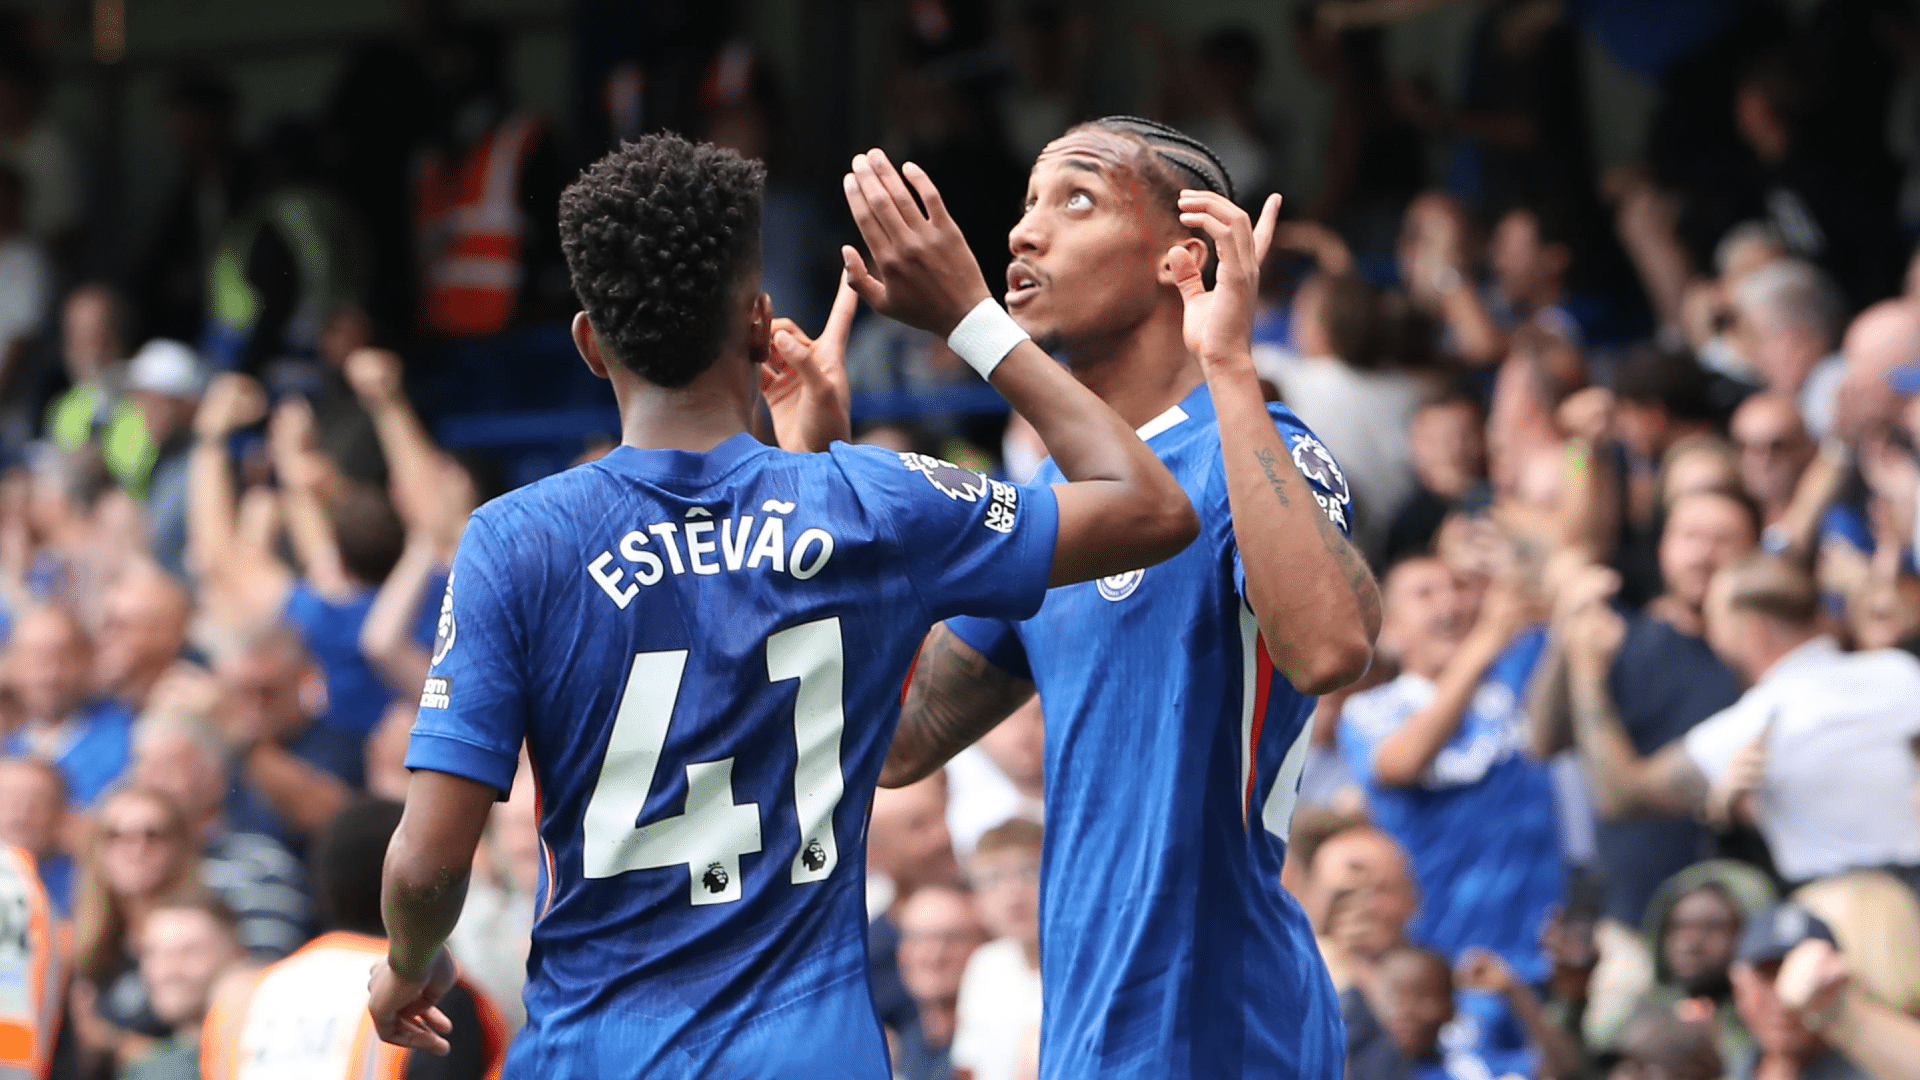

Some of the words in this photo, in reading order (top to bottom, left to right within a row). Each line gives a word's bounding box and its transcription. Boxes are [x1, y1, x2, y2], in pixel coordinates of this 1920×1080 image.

[984, 501, 1003, 531] No
[998, 505, 1016, 533] for
[587, 498, 835, 611] ESTÊVÃO
[583, 615, 845, 906] 41
